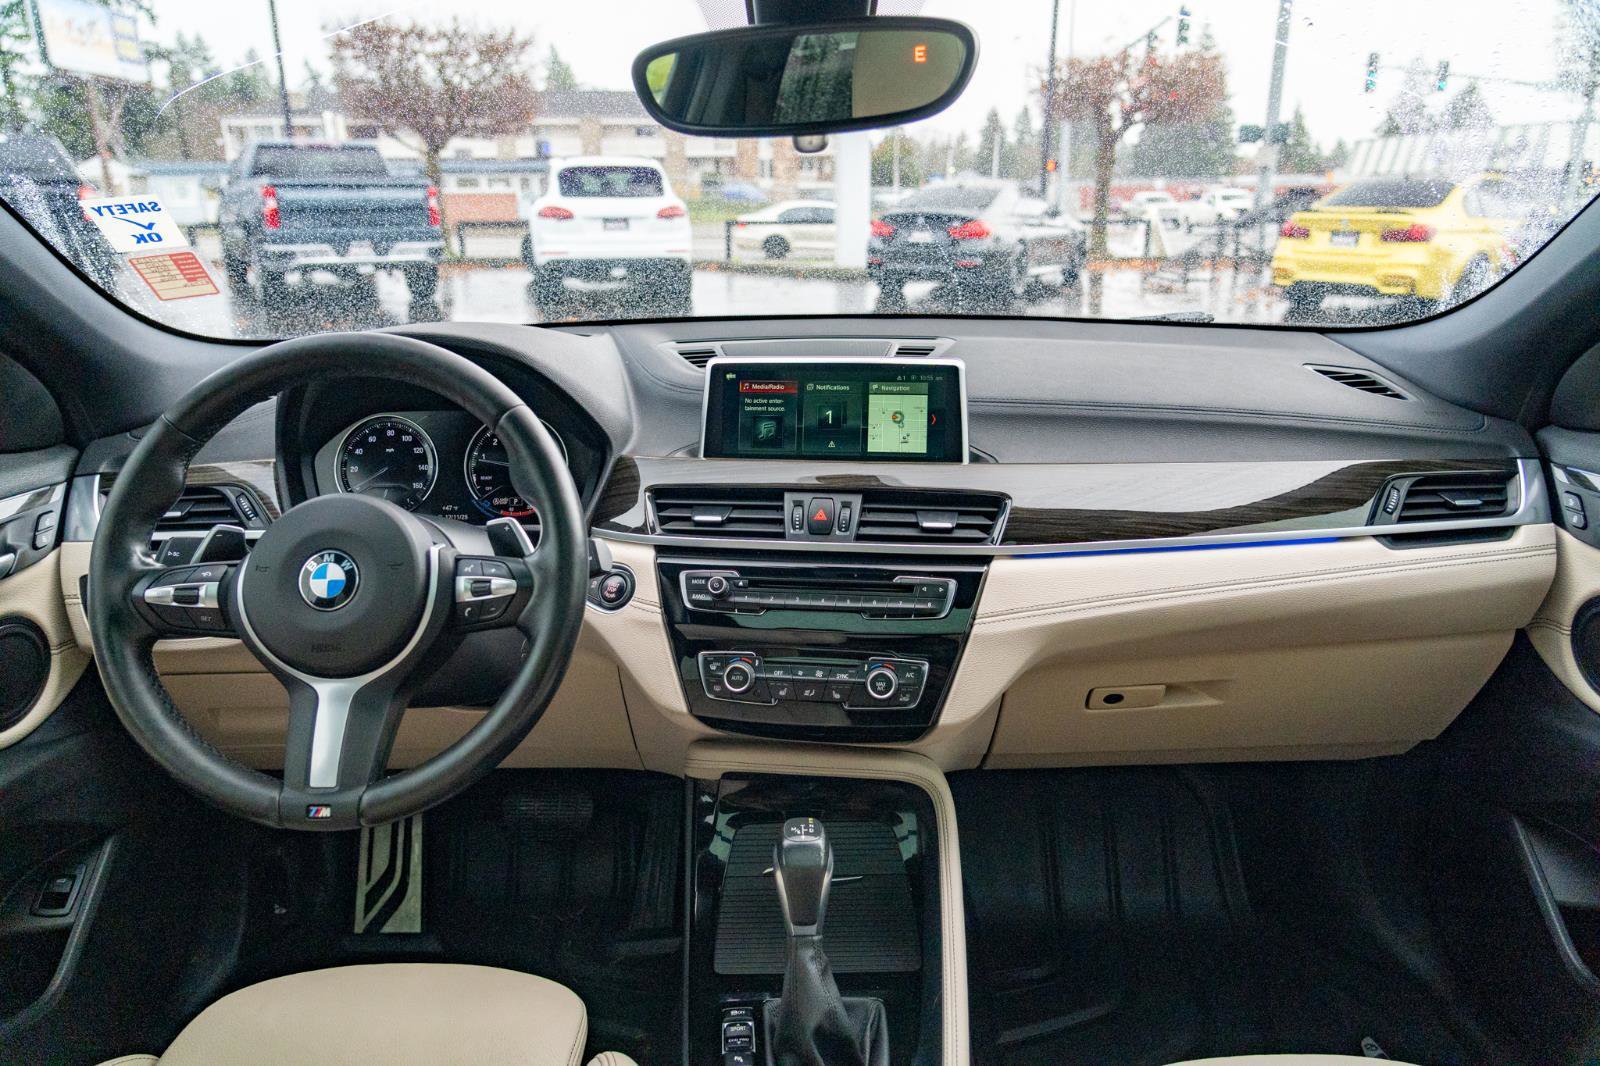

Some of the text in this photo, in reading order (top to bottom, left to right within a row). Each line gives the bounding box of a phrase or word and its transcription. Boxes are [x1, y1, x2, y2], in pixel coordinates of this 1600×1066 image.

[914, 46, 926, 63] E
[825, 410, 833, 424] 1
[386, 429, 395, 437] 80
[368, 435, 377, 443] 60
[492, 438, 498, 446] 2
[350, 465, 359, 473] 20
[306, 553, 353, 572] BMW
[731, 674, 744, 682] AUTO
